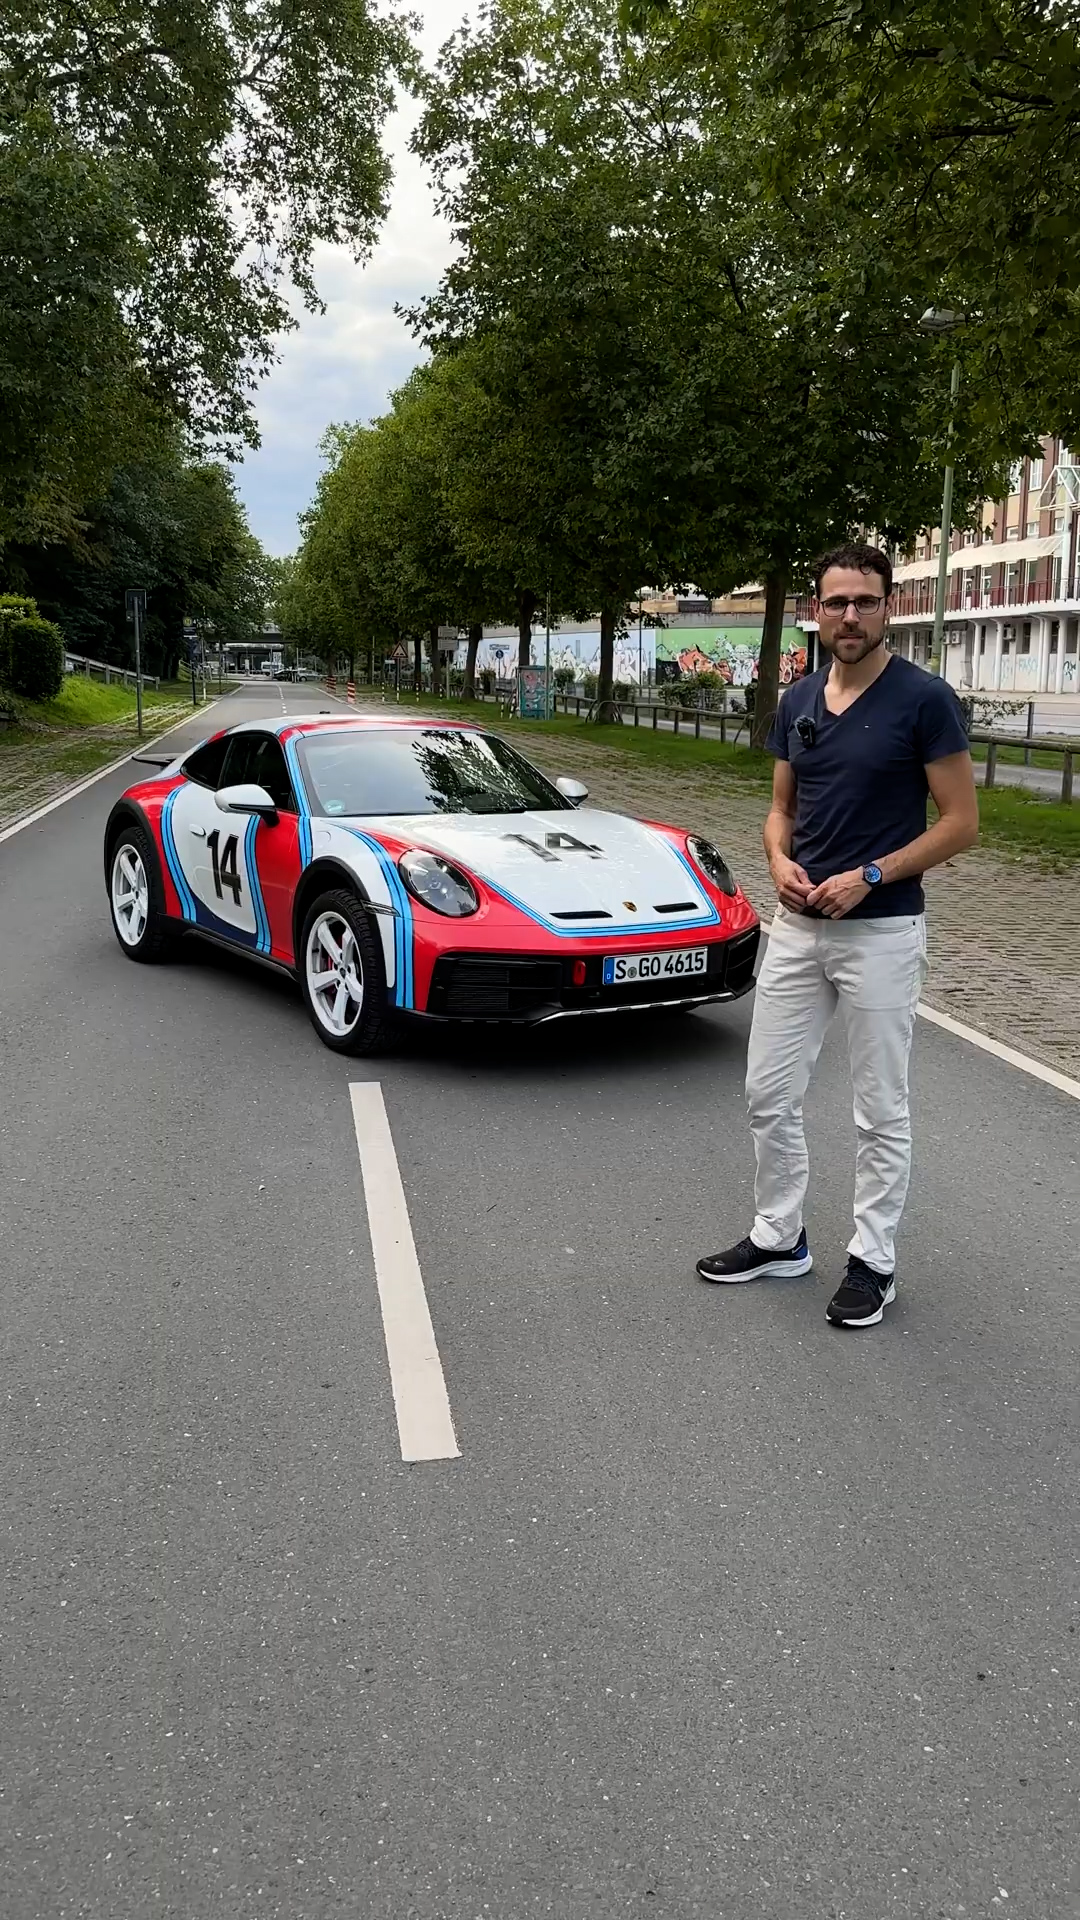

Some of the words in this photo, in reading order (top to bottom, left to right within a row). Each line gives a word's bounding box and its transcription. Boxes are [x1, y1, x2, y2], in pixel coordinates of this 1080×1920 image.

[499, 832, 608, 862] 14
[206, 828, 242, 907] 14
[615, 959, 627, 980] S
[638, 956, 661, 978] GO
[664, 952, 705, 974] 4615
